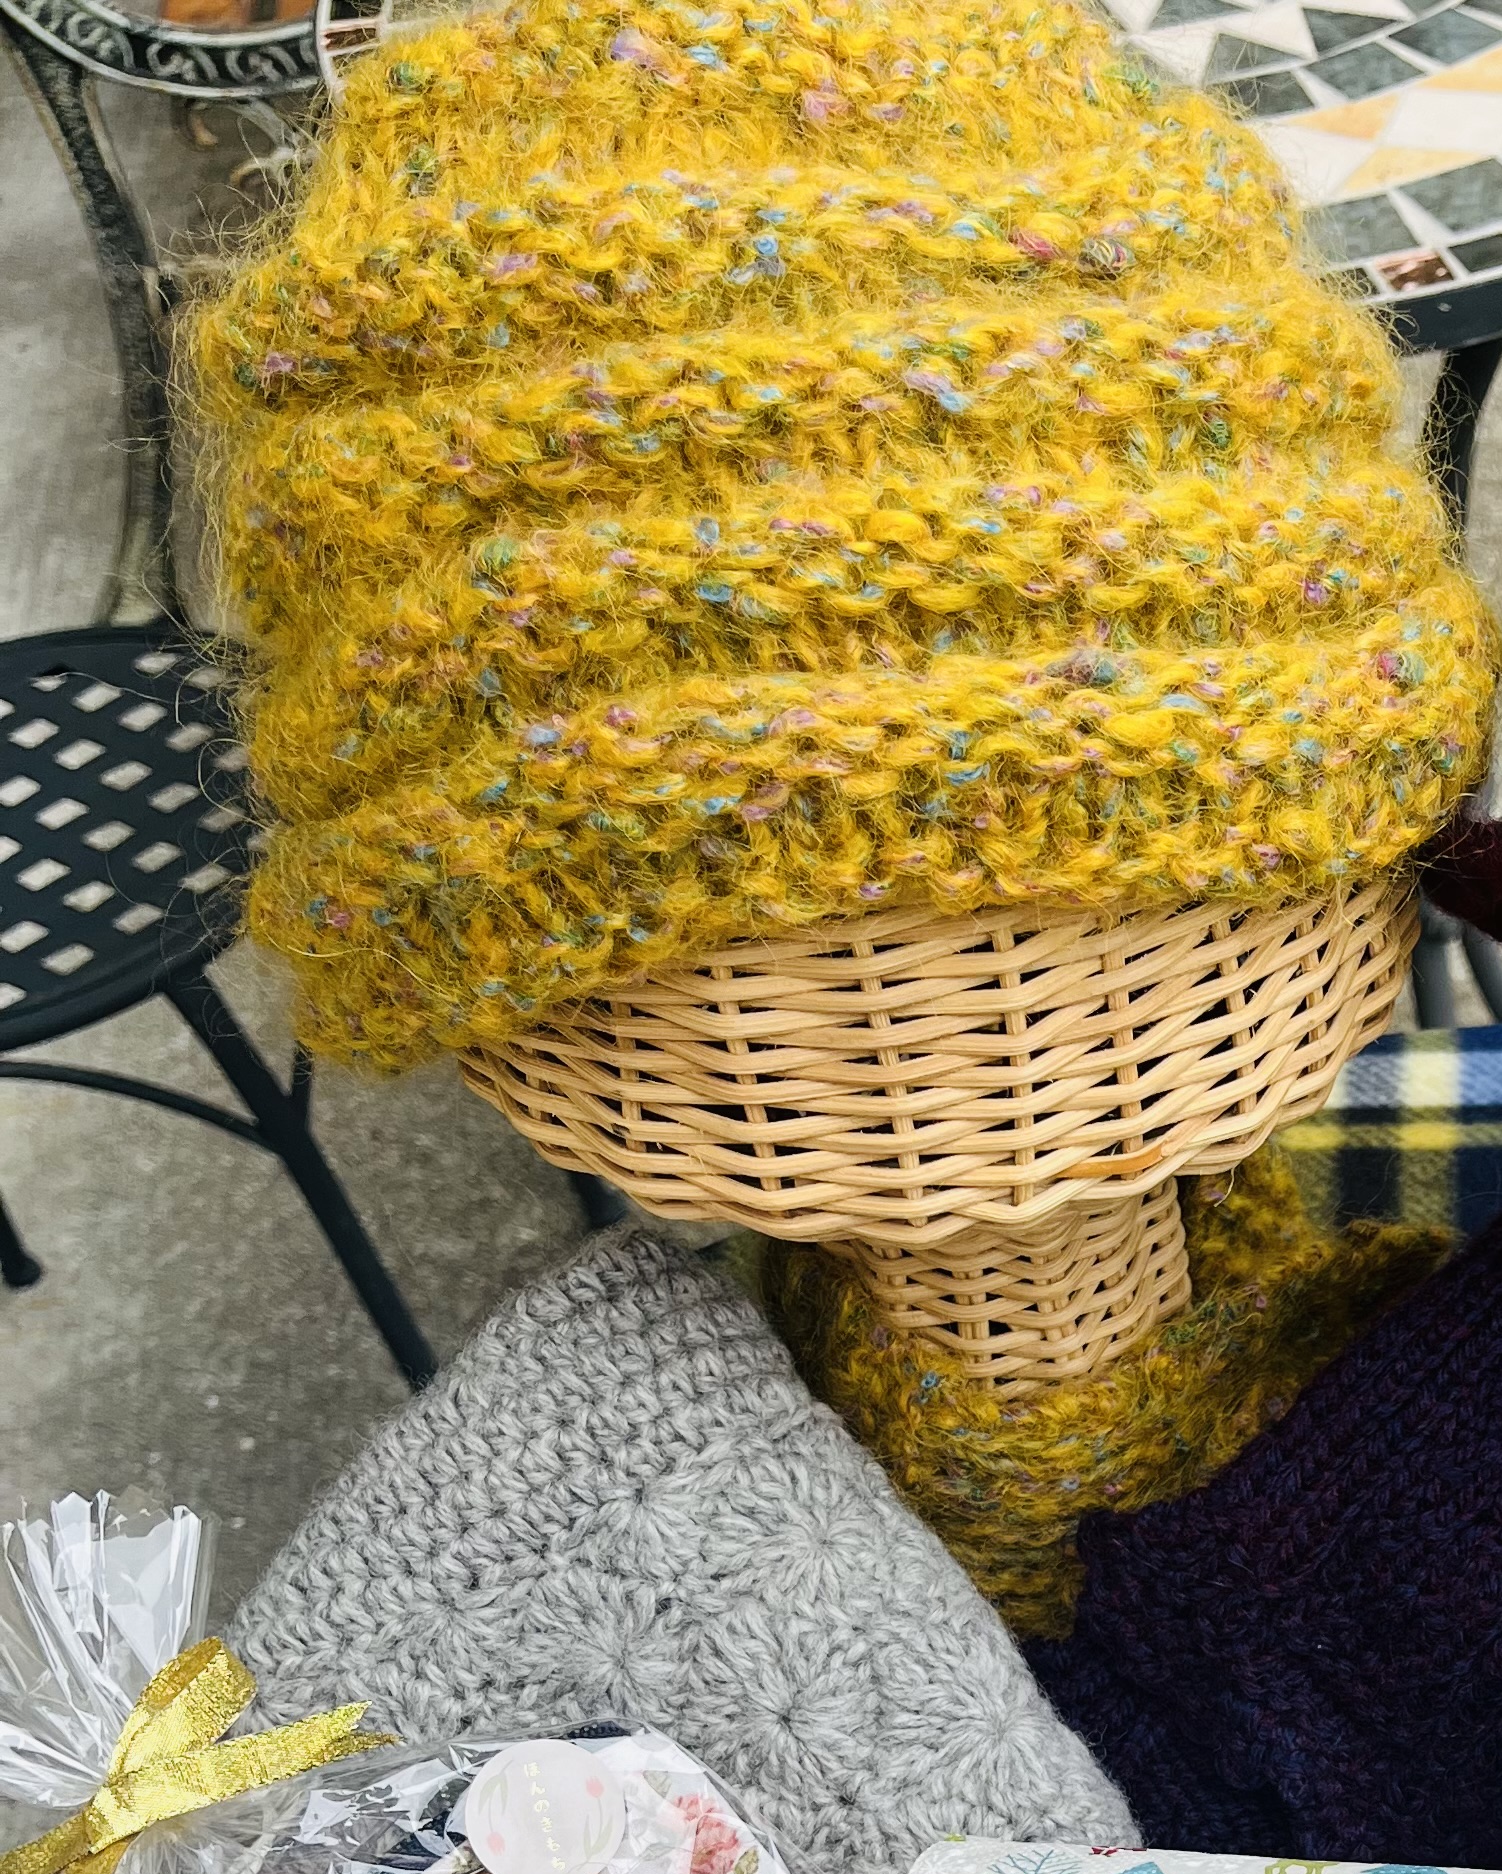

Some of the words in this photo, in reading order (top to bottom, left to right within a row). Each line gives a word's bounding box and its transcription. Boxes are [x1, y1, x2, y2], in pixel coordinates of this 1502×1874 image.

[523, 1761, 566, 1871] ほんのきもち
